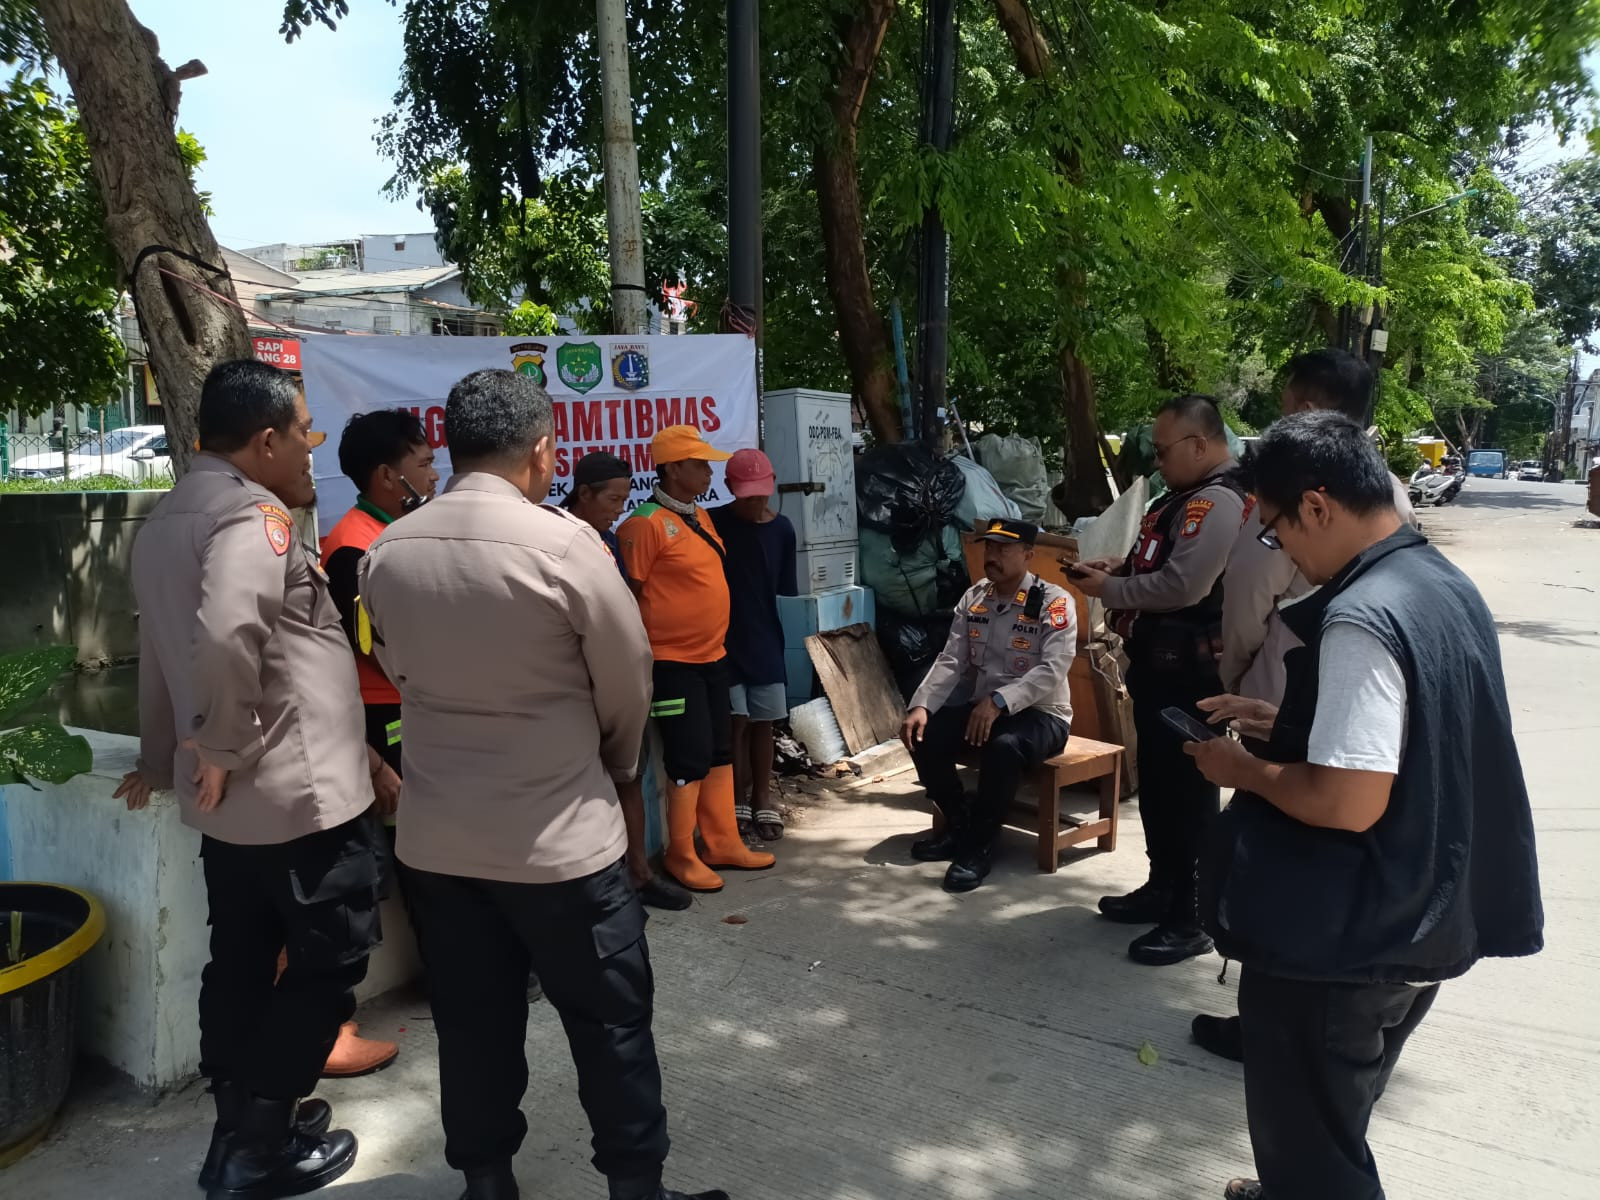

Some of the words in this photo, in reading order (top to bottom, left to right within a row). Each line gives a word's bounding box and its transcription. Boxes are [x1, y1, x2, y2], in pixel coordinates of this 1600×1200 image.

[256, 341, 284, 353] SAPI
[256, 352, 281, 363] ANG
[283, 354, 297, 364] 28
[552, 396, 721, 442] AMTIBMAS
[1011, 623, 1039, 635] POLRI
